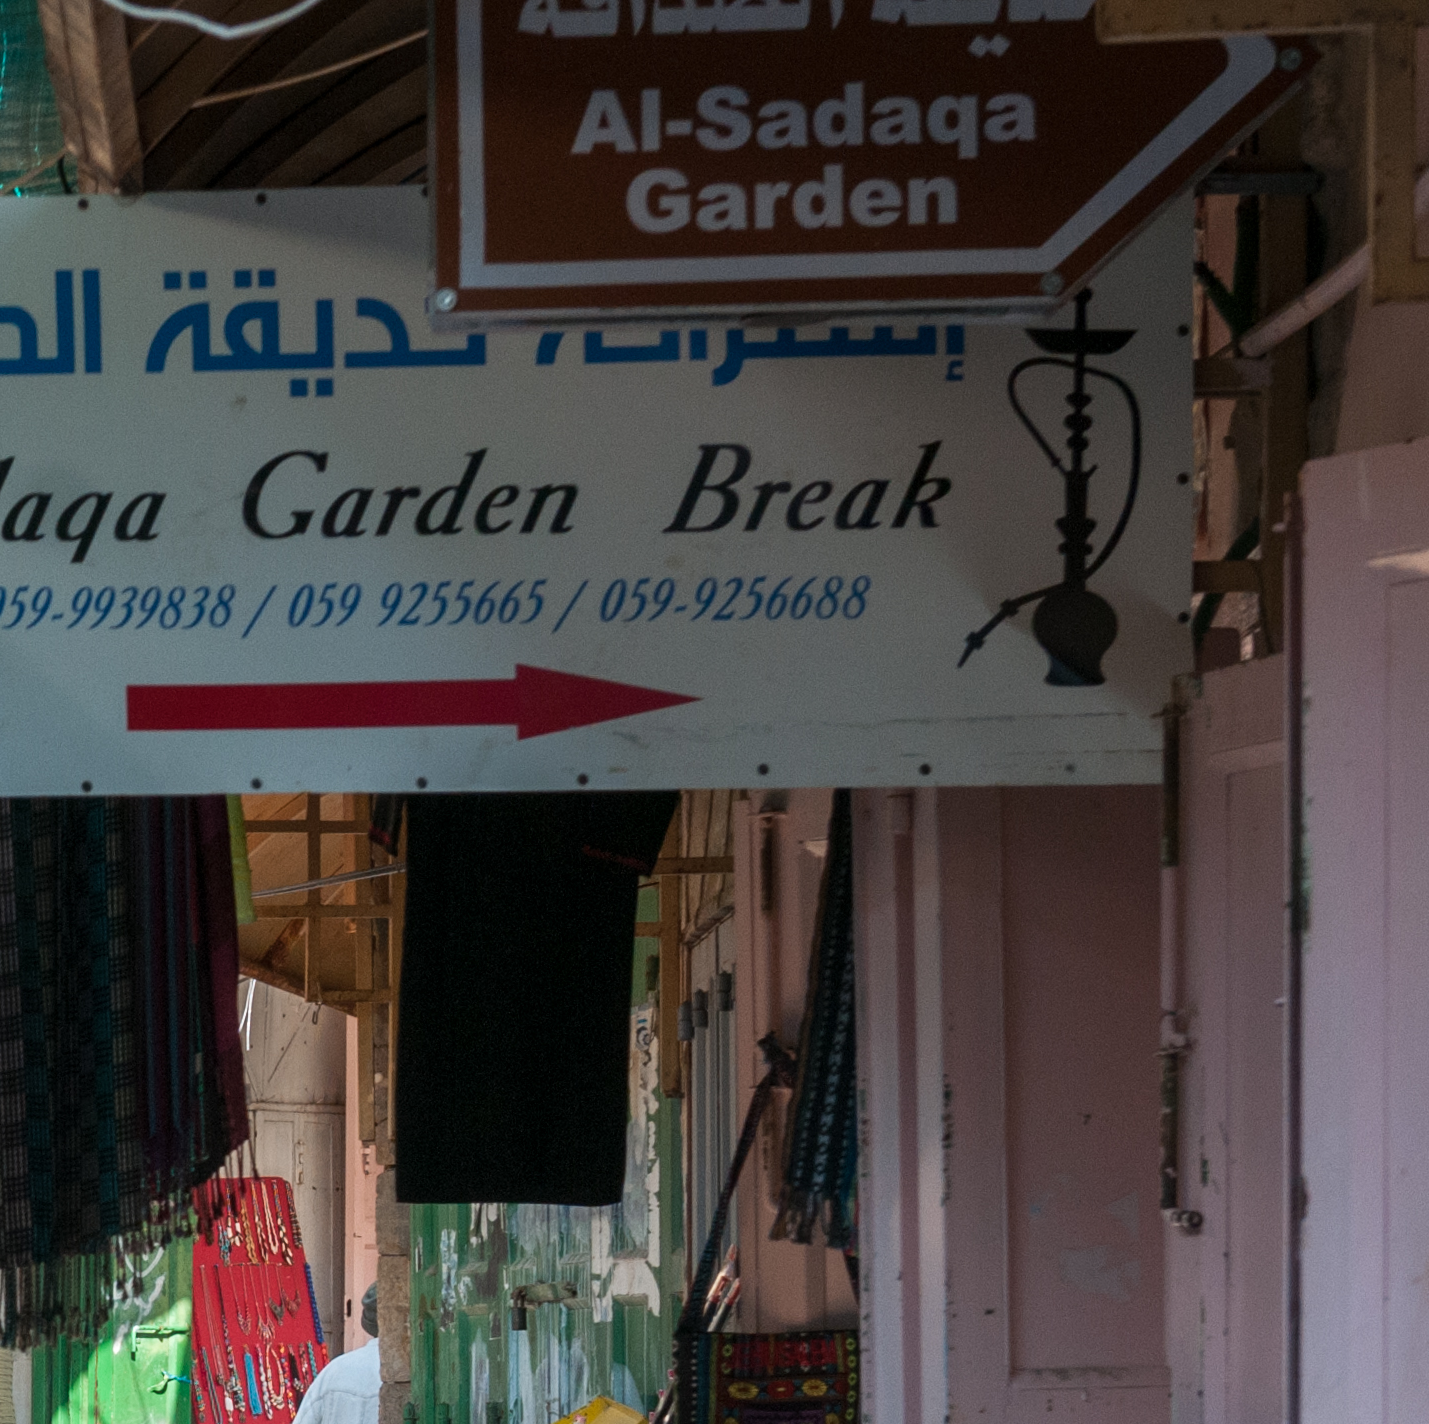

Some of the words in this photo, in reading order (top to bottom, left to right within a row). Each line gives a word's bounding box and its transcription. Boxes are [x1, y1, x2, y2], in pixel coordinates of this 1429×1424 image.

[571, 82, 1037, 159] Al-Sadaqa
[625, 165, 958, 233] Garden
[242, 448, 579, 540] Garden
[663, 440, 954, 535] Break
[287, 582, 363, 628] 059
[377, 578, 547, 628] 9255665
[599, 575, 872, 623] 059-9256688
